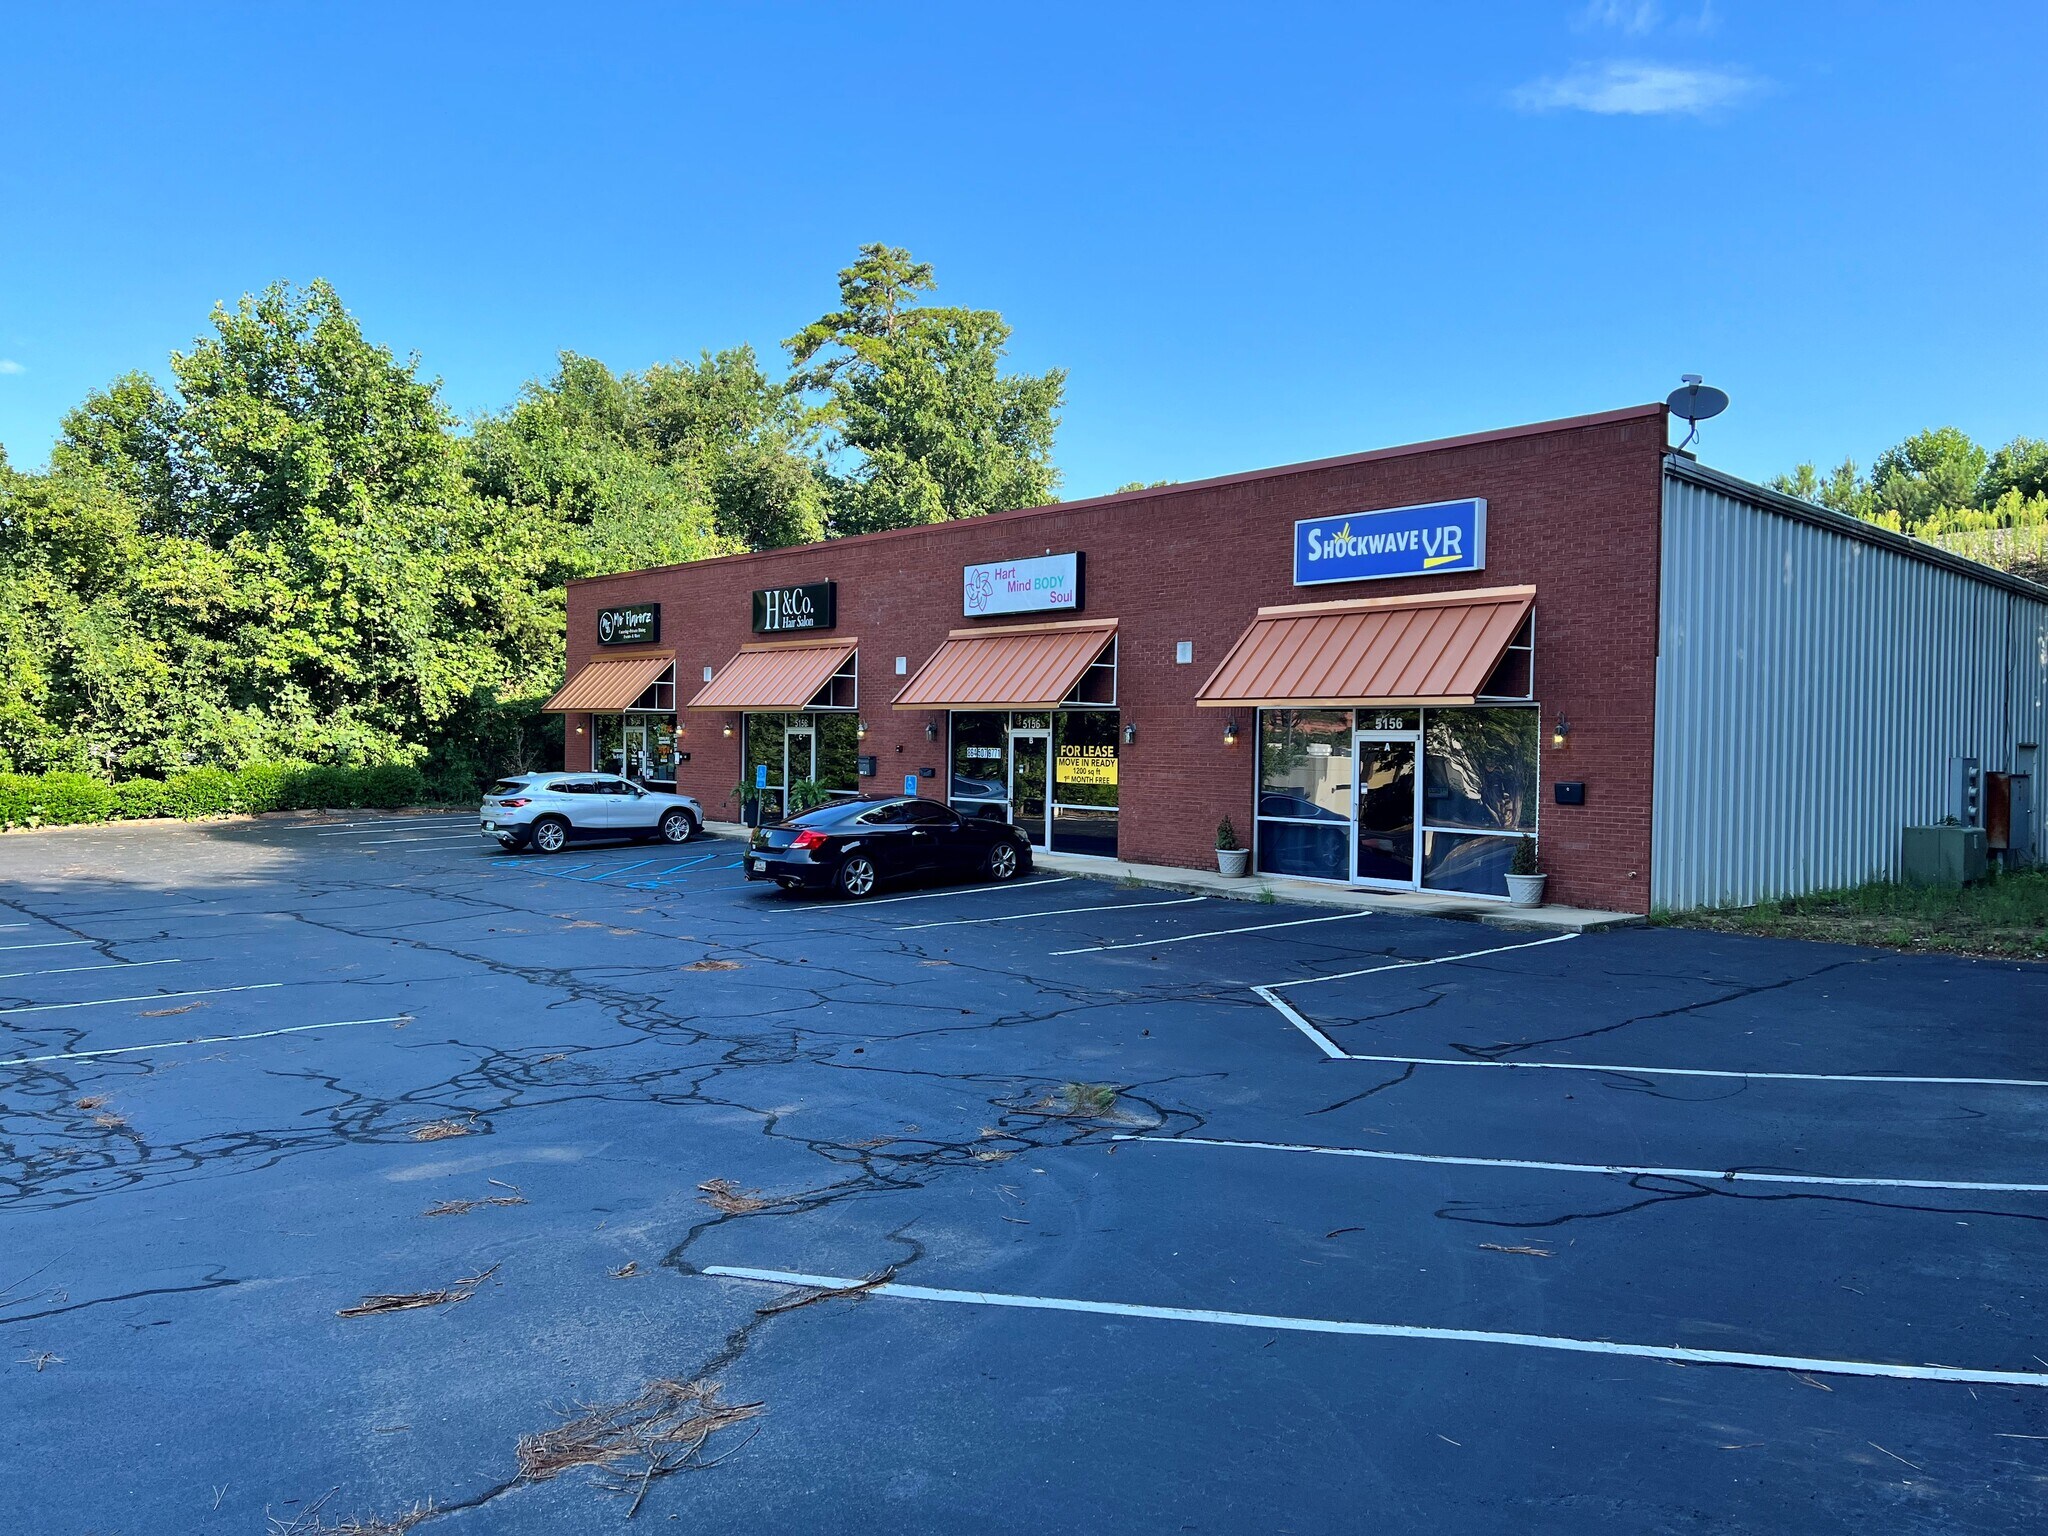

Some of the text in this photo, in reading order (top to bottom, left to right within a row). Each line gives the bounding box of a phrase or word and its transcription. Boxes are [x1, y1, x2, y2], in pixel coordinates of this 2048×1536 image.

[1422, 525, 1463, 557] VR
[994, 567, 1016, 581] Hart
[1007, 575, 1065, 593] Mind BODY
[1050, 590, 1073, 604] Soul
[782, 615, 814, 628] Hair Salon
[1022, 719, 1041, 729] 5156
[1375, 717, 1403, 730] 5156
[1060, 745, 1114, 757] FOR LEASE
[1384, 743, 1391, 751] A
[1058, 758, 1116, 767] MOVE IN READY
[1073, 767, 1086, 775] 1200
[1096, 767, 1101, 775] ft
